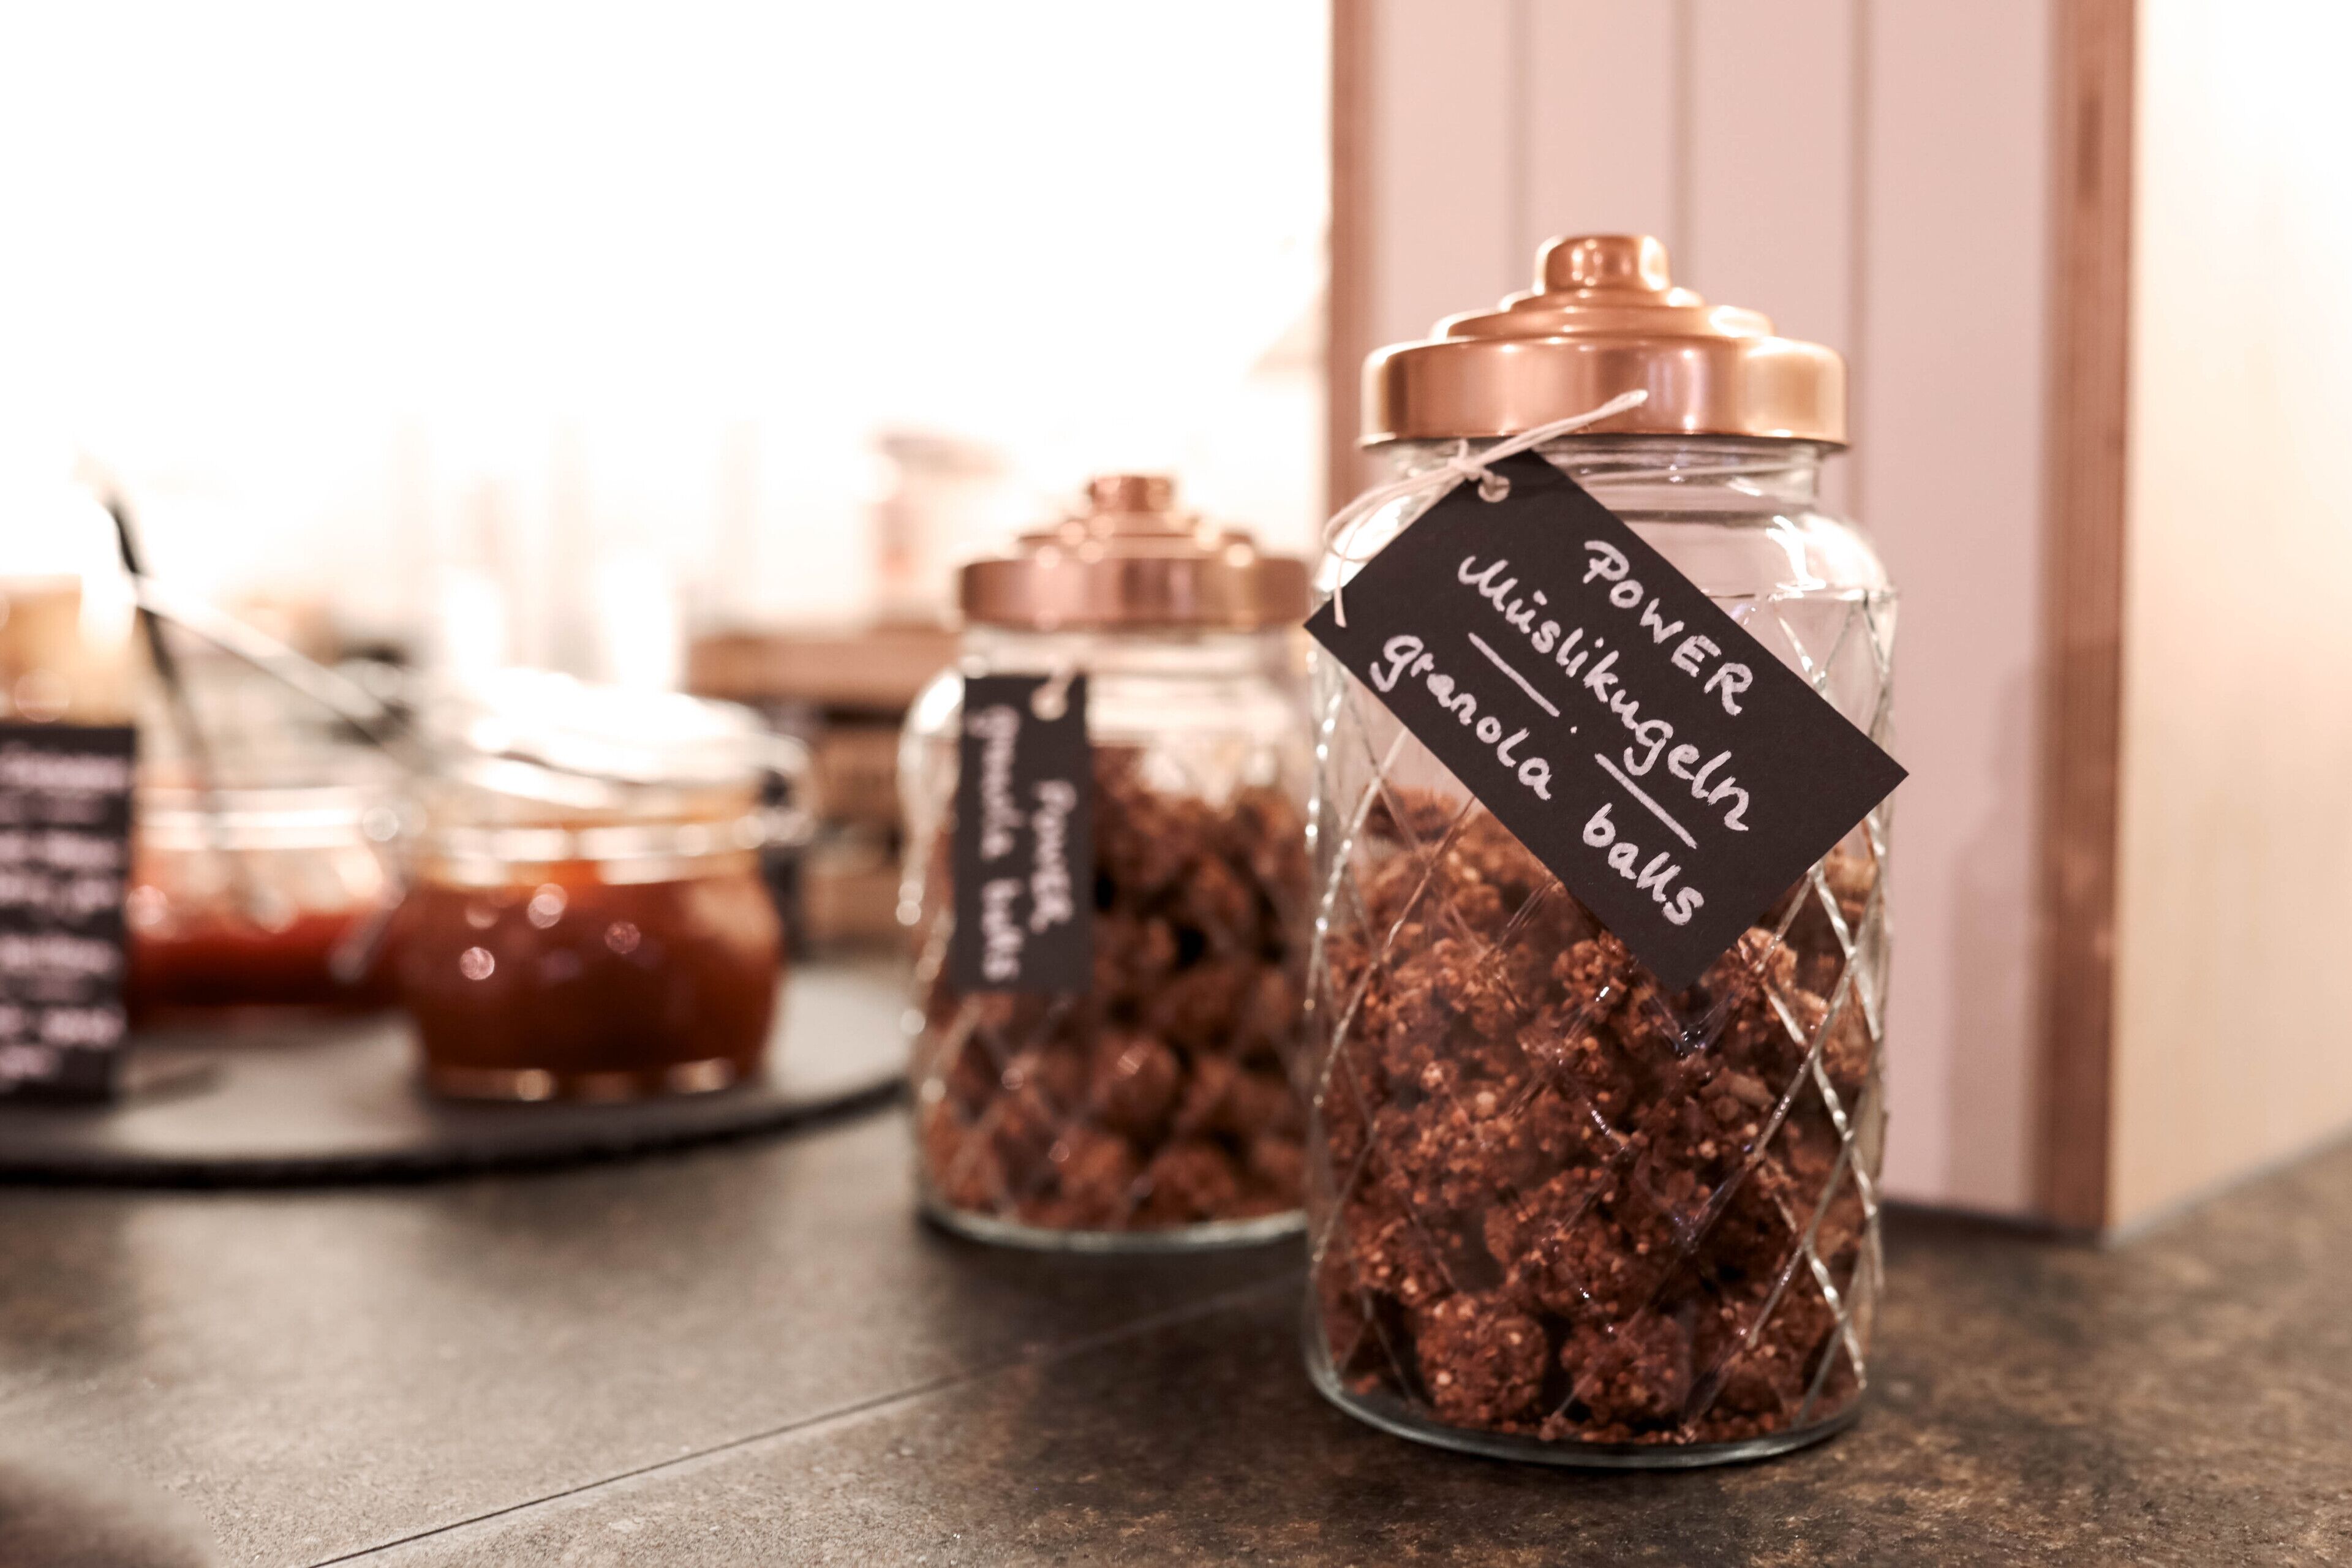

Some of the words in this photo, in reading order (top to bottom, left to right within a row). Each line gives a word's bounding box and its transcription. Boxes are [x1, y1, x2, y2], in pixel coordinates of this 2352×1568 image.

[1457, 555, 1750, 832] Müslikugeln
[1582, 539, 1754, 717] POWER
[1369, 634, 1553, 802] granola
[1581, 802, 1705, 926] balls
